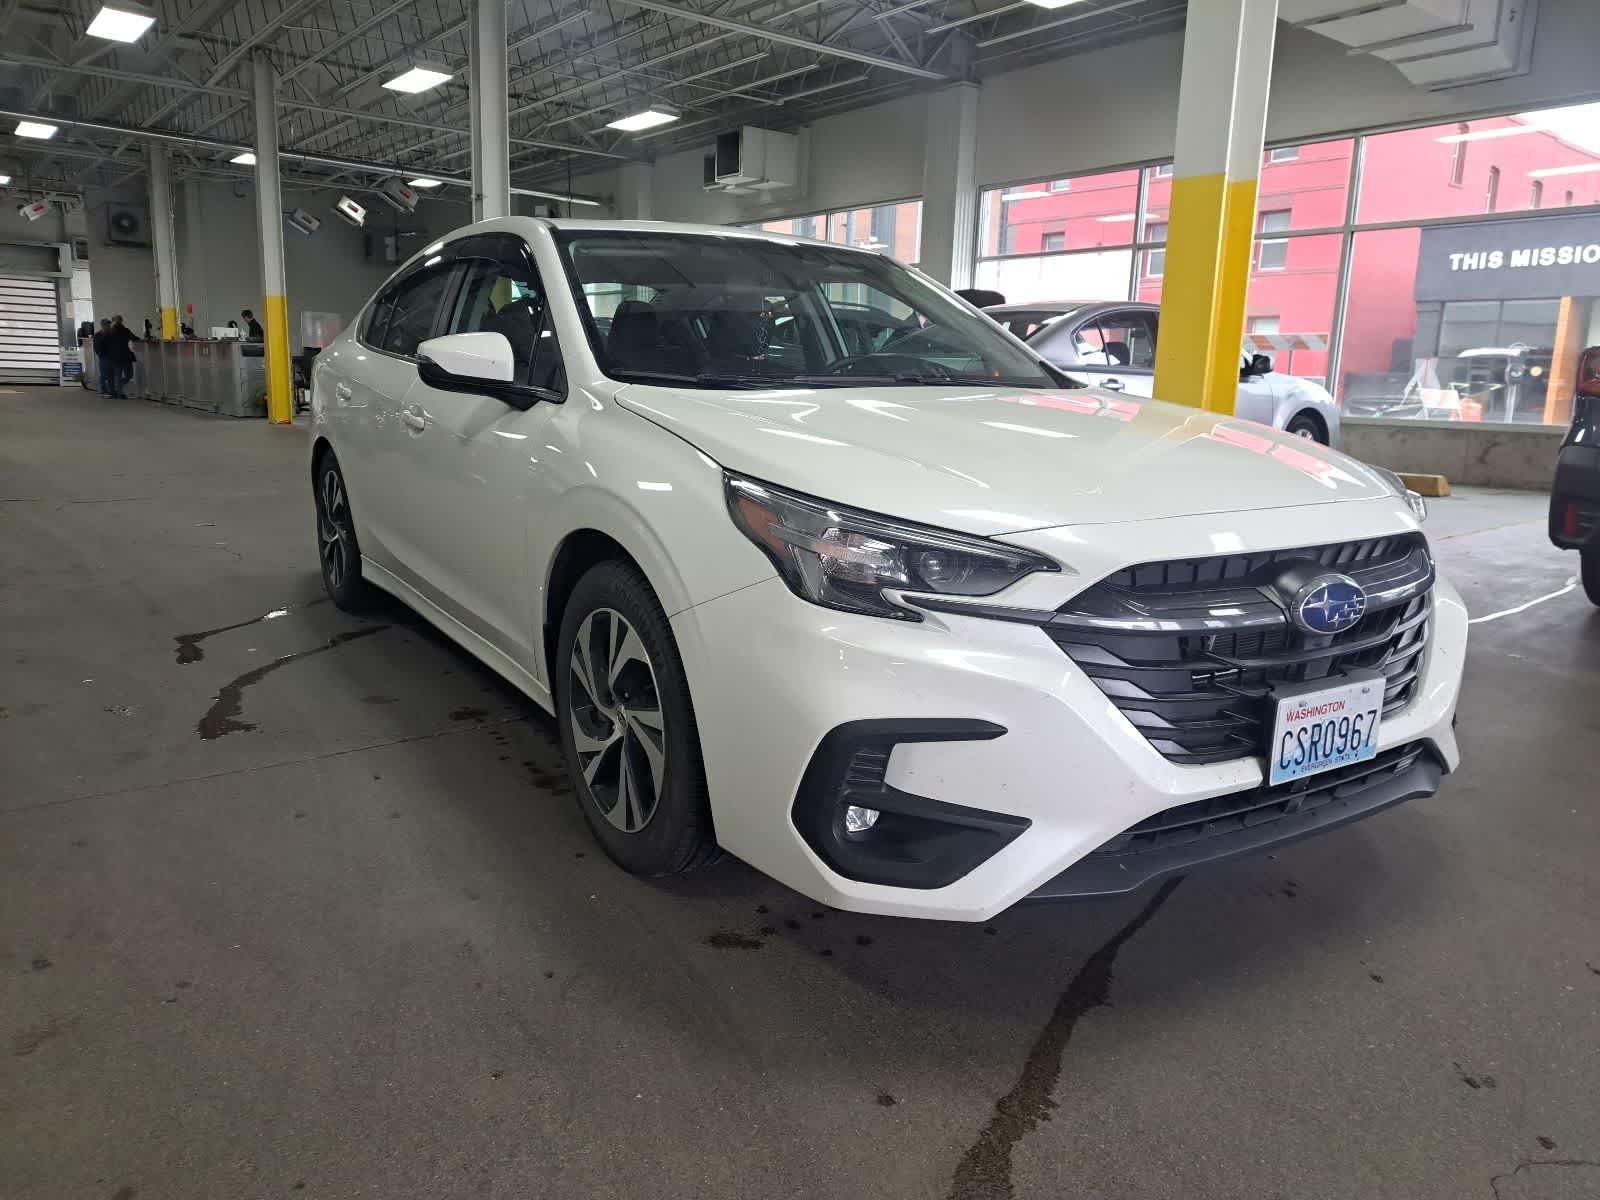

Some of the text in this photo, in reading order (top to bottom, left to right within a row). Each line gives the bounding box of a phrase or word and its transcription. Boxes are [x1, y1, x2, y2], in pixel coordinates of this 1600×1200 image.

[1449, 250, 1504, 270] THIS
[1286, 701, 1345, 722] WASHINGTON
[1280, 710, 1377, 769] CSR0967
